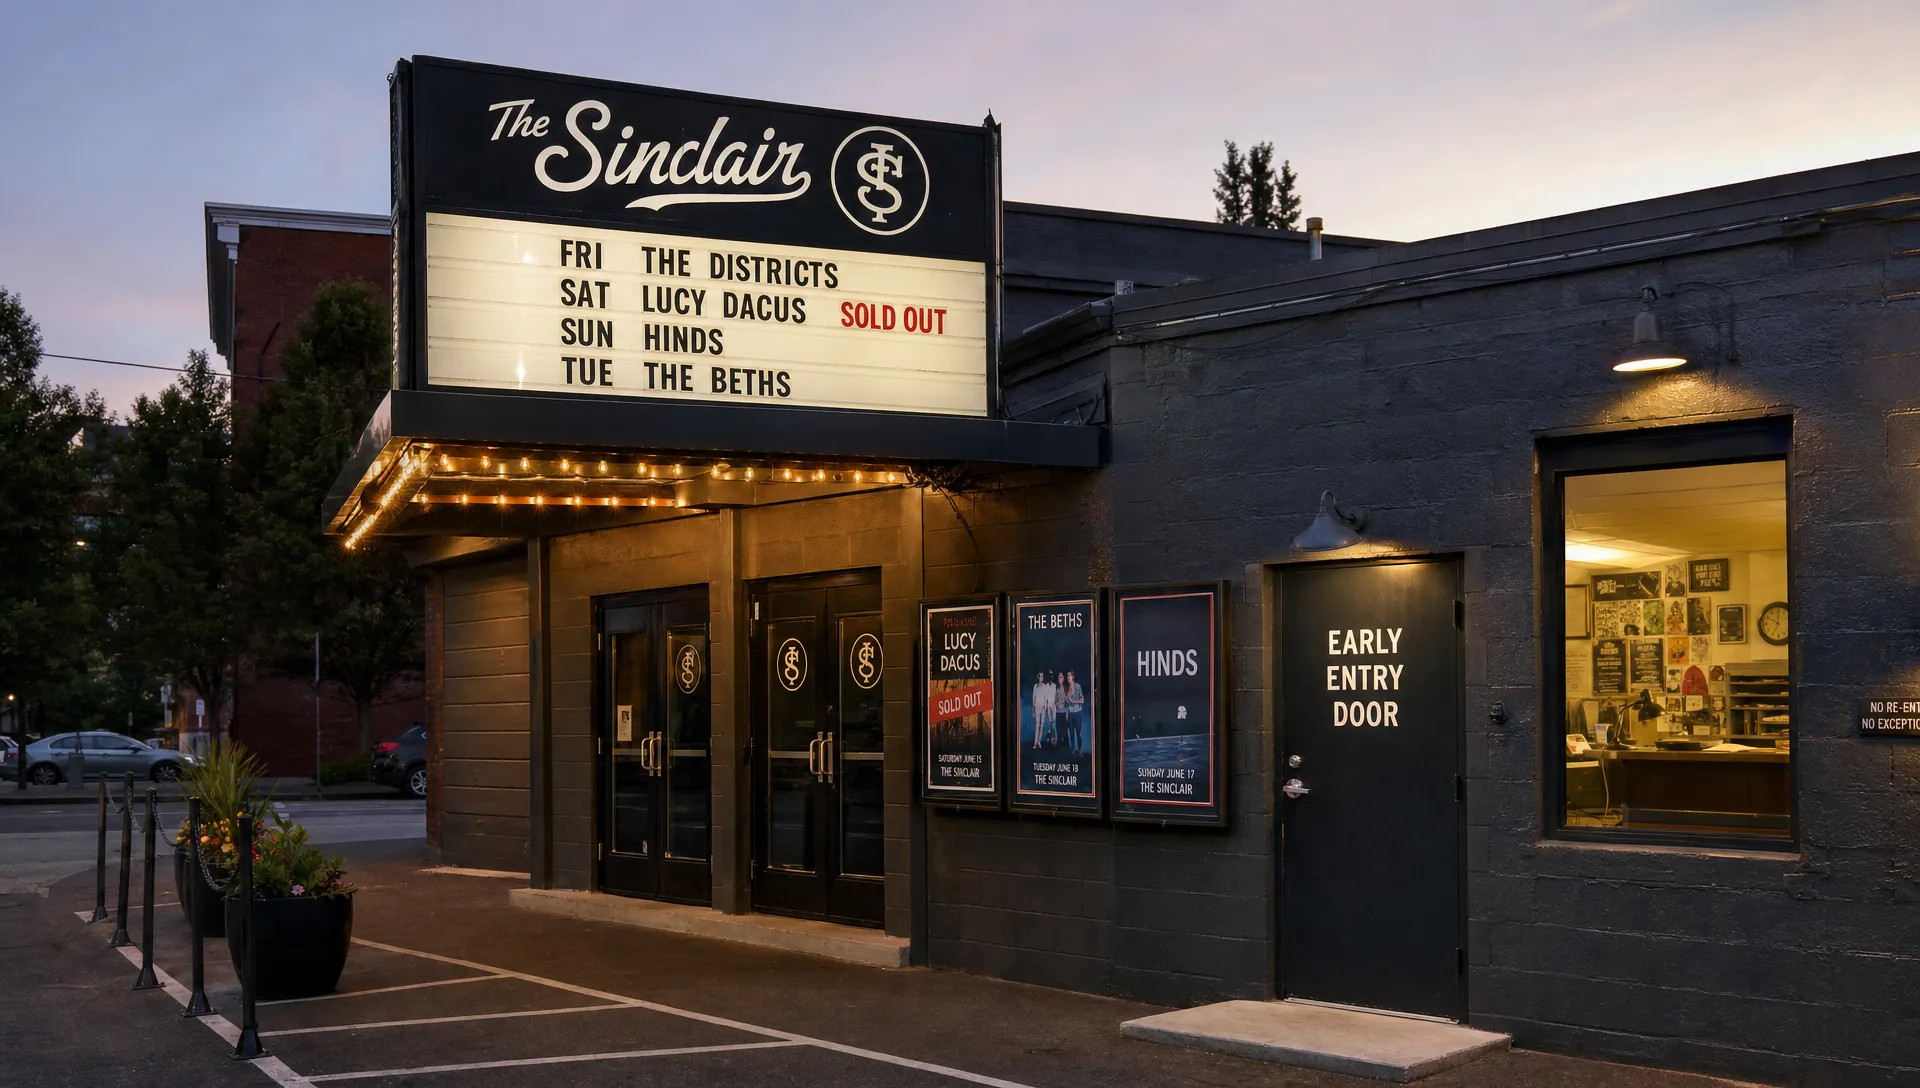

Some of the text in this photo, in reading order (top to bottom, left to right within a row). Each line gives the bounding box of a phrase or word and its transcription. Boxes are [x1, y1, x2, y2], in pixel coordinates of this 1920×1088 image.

[488, 99, 550, 141] The
[534, 100, 811, 211] Sinclair
[560, 239, 838, 289] FRI THE DISTRICTS
[560, 279, 947, 334] SAT LUCY DACUS SOLD OUT
[561, 318, 724, 355] SUN HINDS
[561, 357, 791, 397] TUE THE BETHS
[1028, 612, 1083, 630] THE BETHS
[944, 632, 977, 650] LUCY
[1328, 628, 1403, 655] EARLY
[940, 654, 980, 671] DACUS
[1138, 649, 1198, 677] HINDS
[1327, 664, 1404, 691] ENTRY
[938, 691, 982, 715] SOLD OUT
[1870, 701, 1884, 713] NO
[1333, 701, 1399, 727] DOOR
[1861, 718, 1875, 729] NO
[938, 754, 962, 763] SATURDAY
[963, 755, 976, 763] JUNE
[1033, 762, 1056, 772] TUESDAY
[1057, 763, 1071, 773] JUNE
[941, 766, 952, 777] THE
[1034, 774, 1077, 786] THE SINCLAIR
[1138, 767, 1195, 779] SUNDAY JUNE 17
[1140, 782, 1193, 795] THE SINCLAIR
